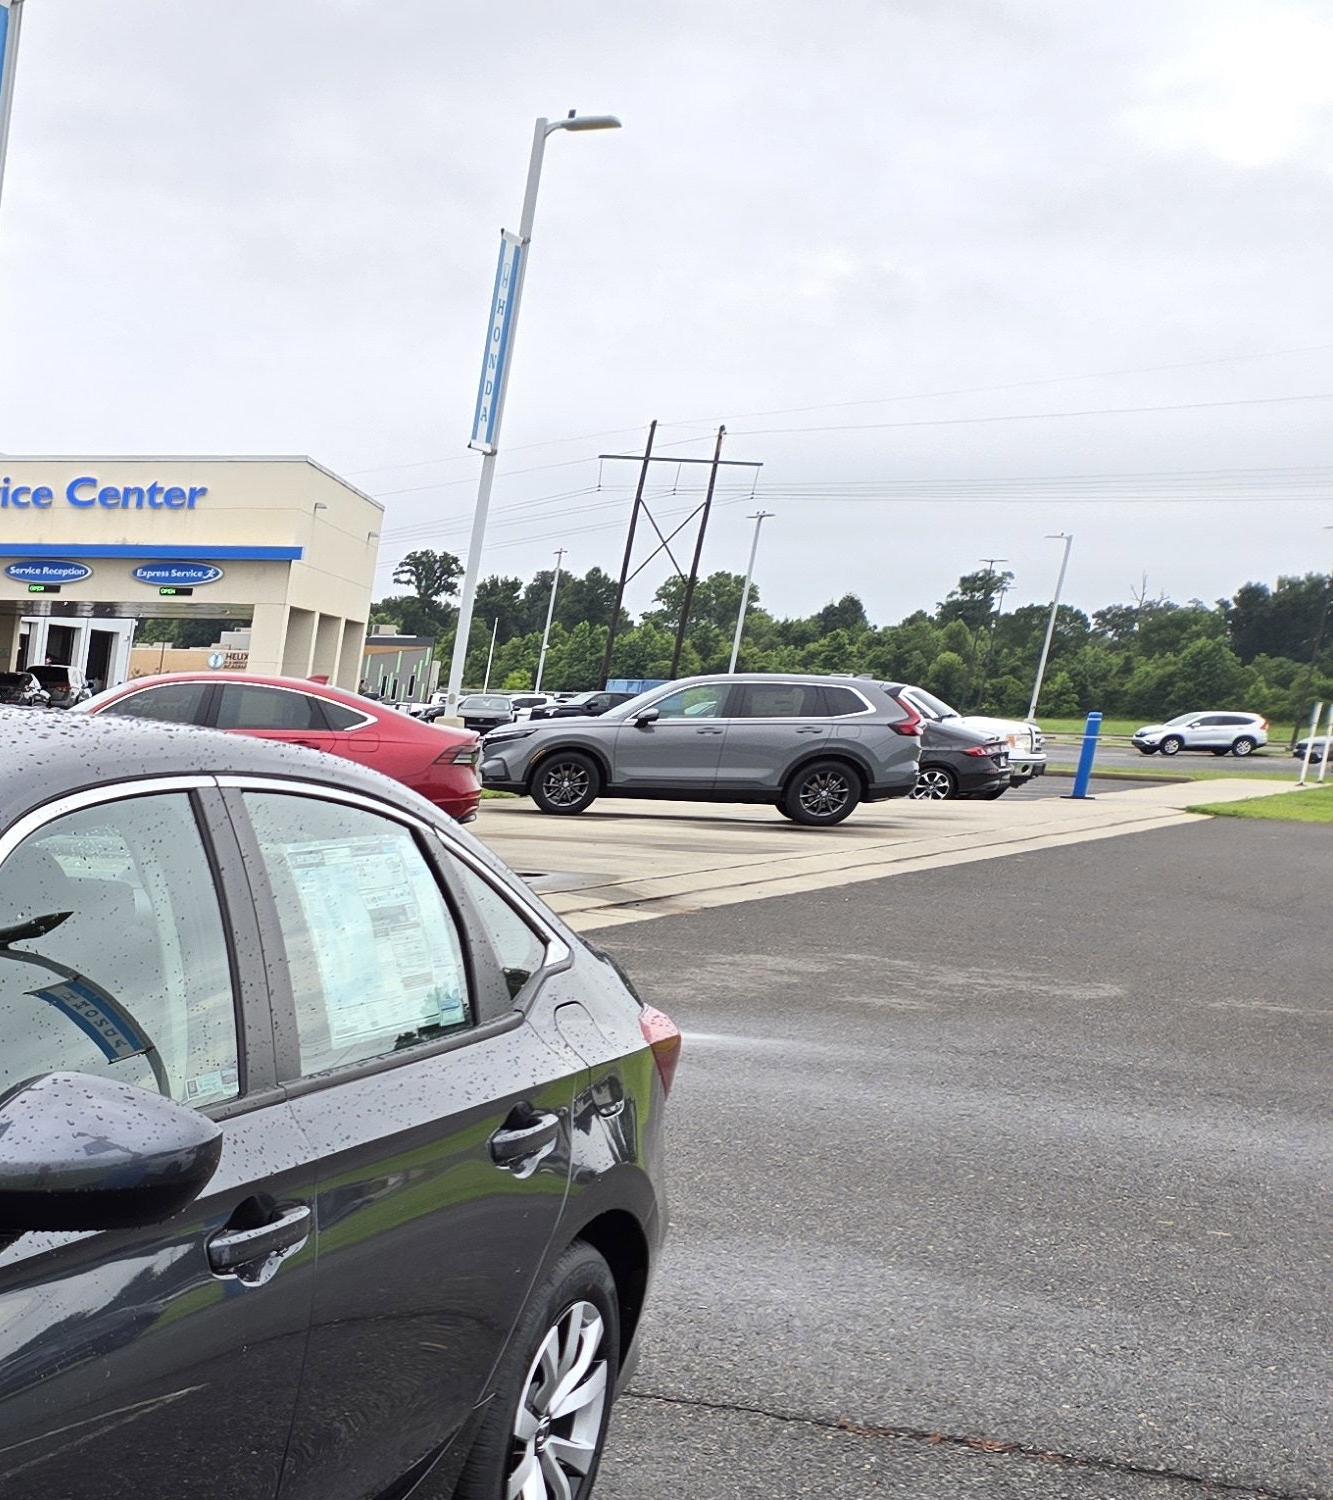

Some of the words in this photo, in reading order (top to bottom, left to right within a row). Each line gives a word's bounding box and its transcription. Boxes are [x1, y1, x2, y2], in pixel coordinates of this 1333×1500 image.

[479, 299, 506, 423] HONDA
[66, 476, 208, 510] Center
[10, 566, 41, 575] Service
[43, 566, 86, 577] Reception
[136, 568, 169, 579] Express
[171, 568, 203, 578] Service
